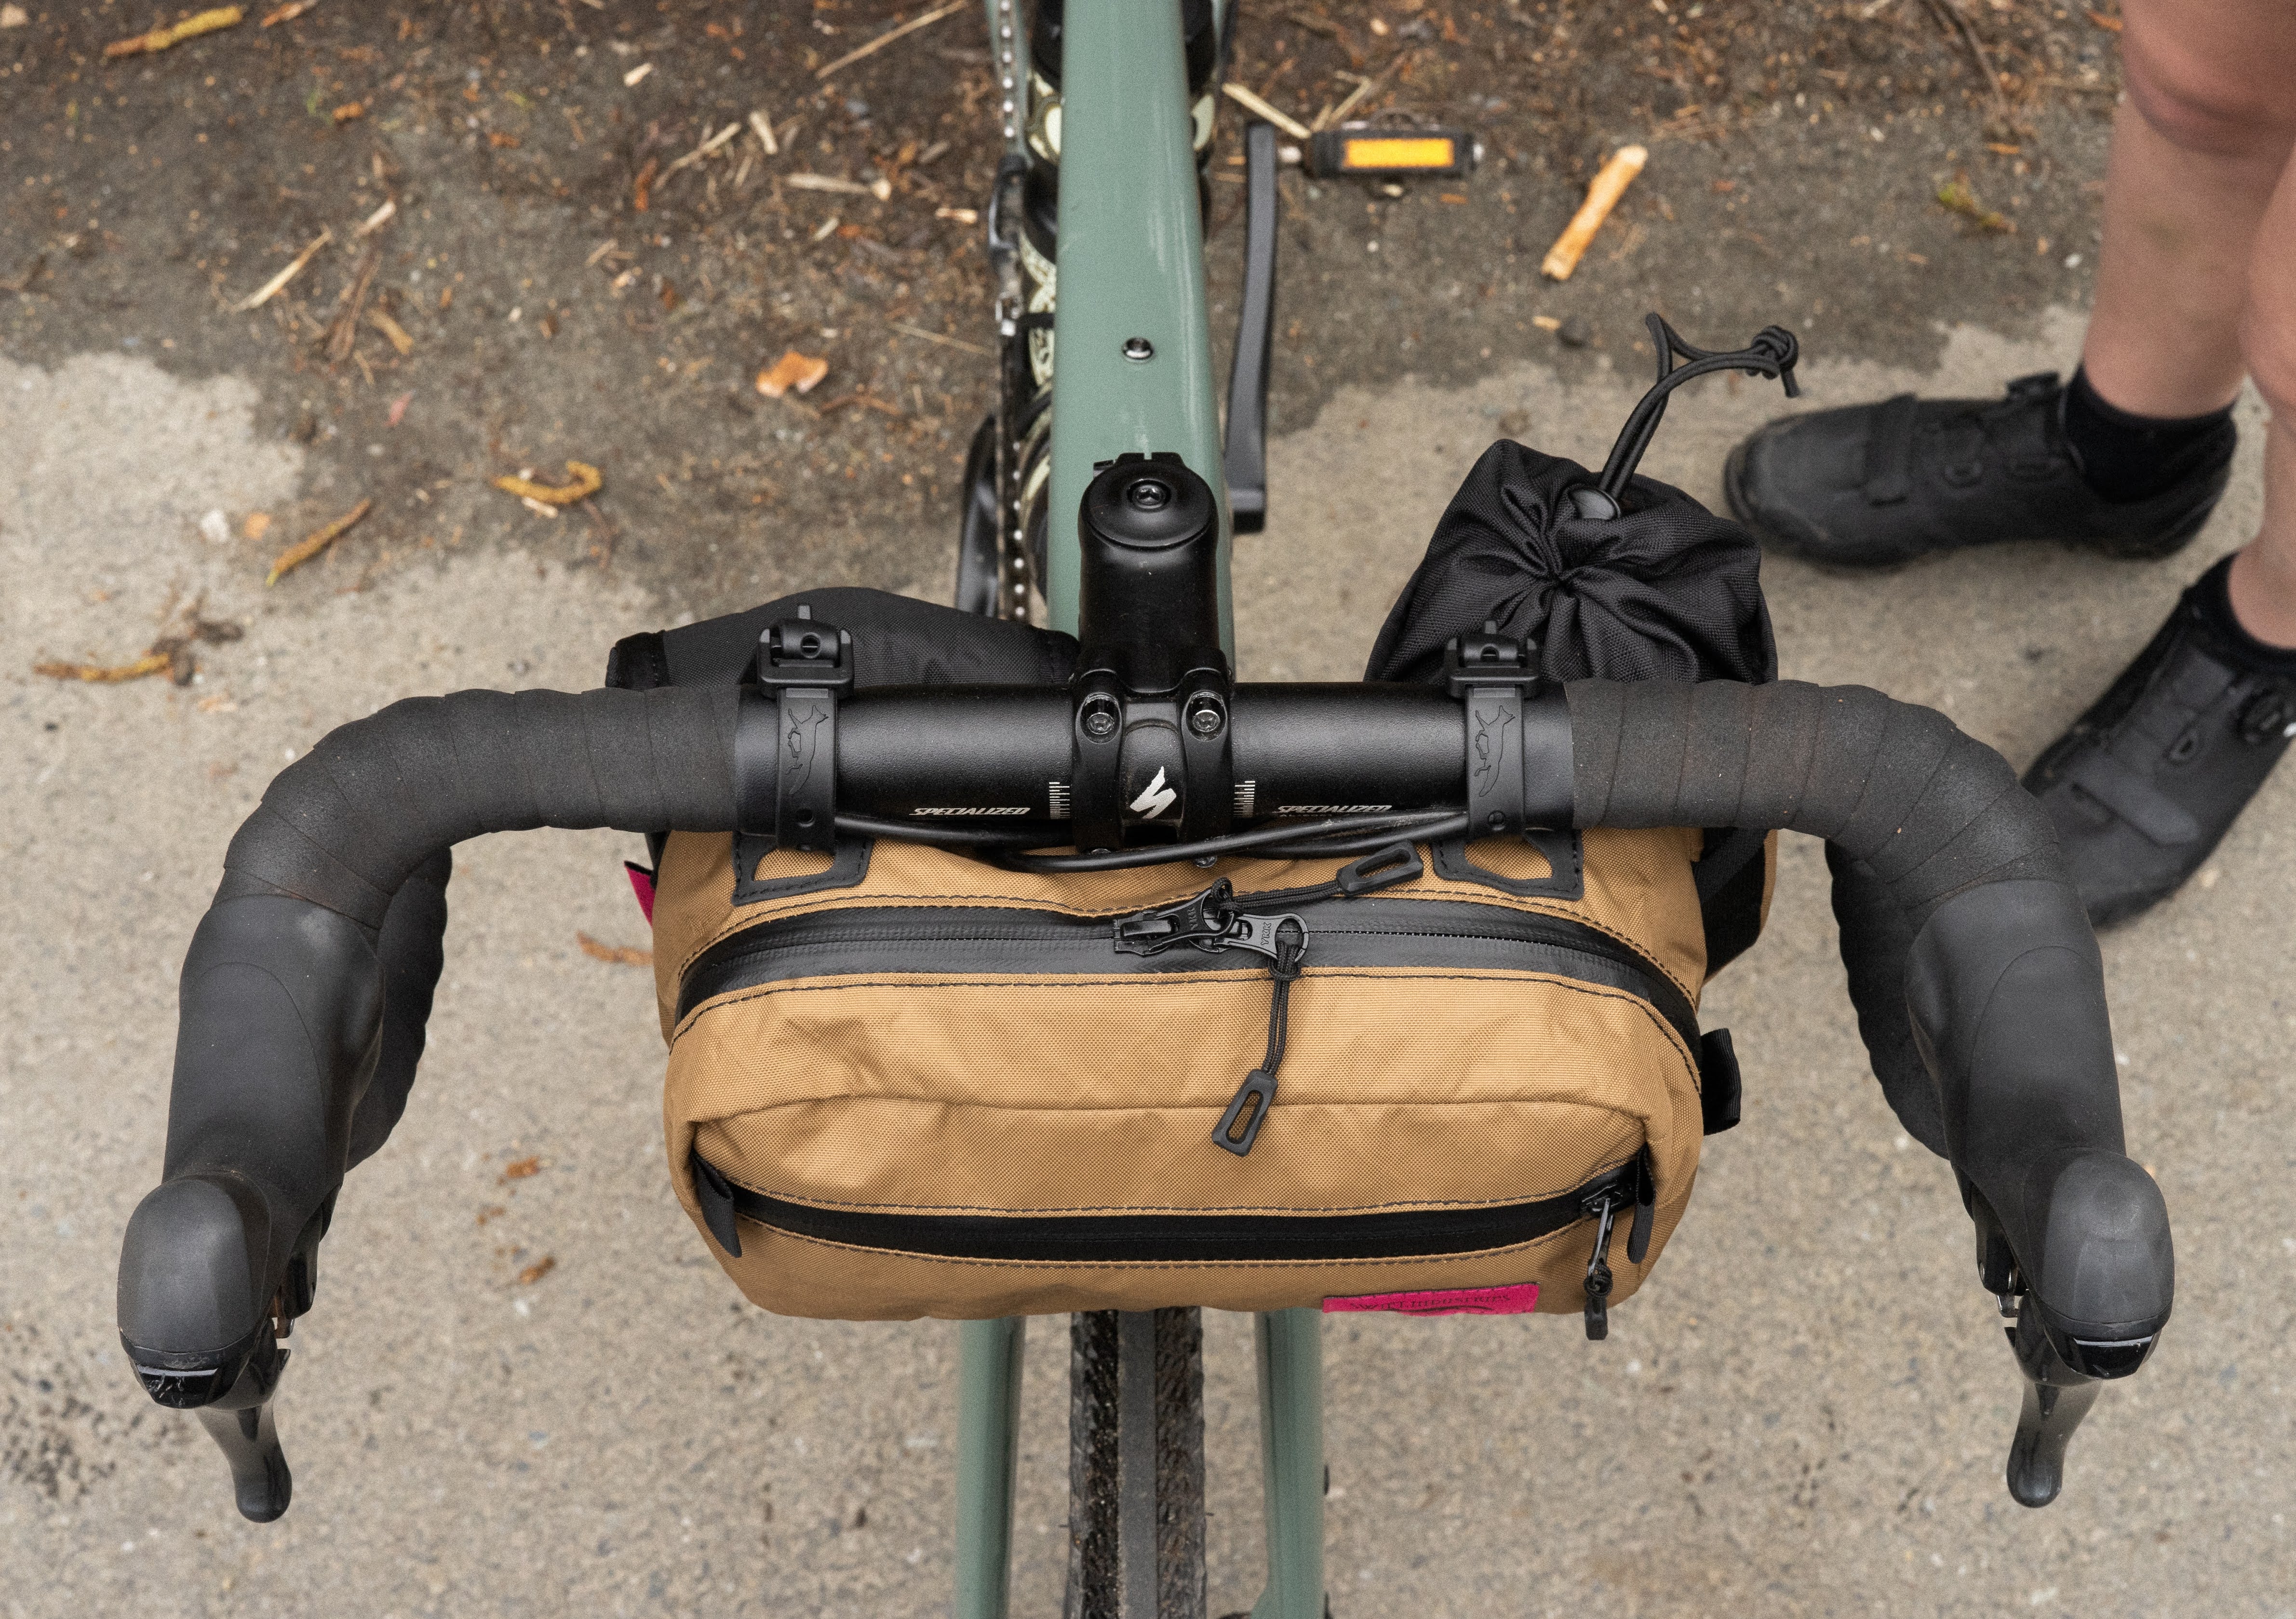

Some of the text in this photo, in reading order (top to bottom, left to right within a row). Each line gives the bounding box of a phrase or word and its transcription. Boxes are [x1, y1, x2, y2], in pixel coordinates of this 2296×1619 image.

[909, 807, 1031, 815] SPECIALIZED
[1272, 805, 1393, 813] SPECIALIZED
[1261, 922, 1272, 945] YKK
